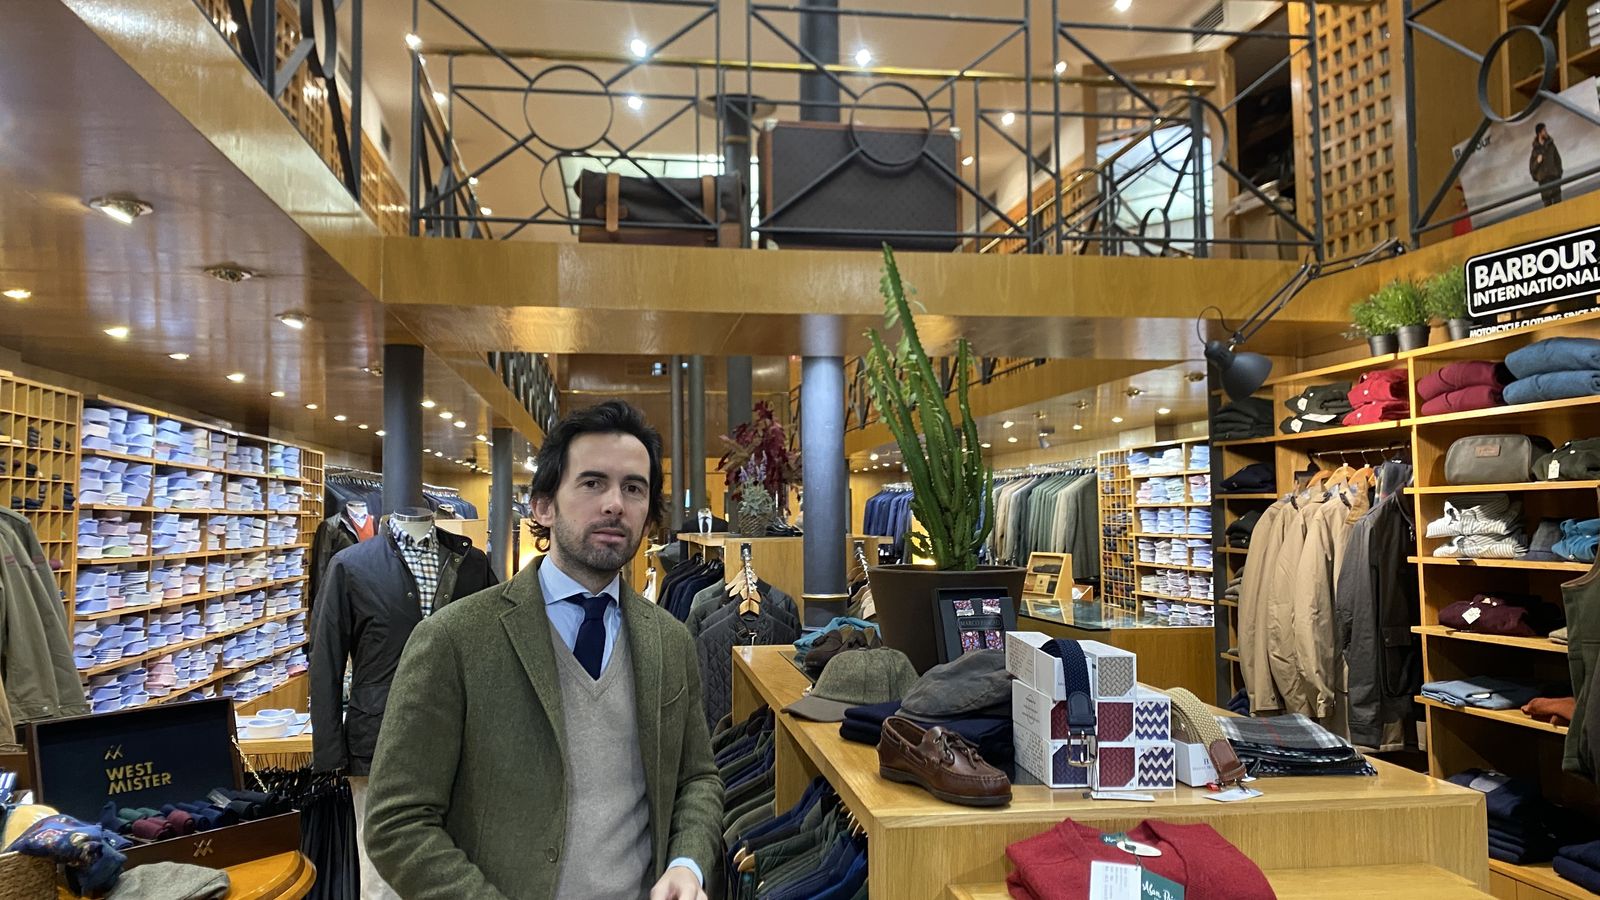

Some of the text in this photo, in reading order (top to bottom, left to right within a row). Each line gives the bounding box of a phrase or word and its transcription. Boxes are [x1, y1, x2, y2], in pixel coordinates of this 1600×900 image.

[1455, 135, 1491, 160] Bour
[1474, 239, 1597, 290] BARBOUR
[1473, 267, 1600, 307] INTERNATIONAL
[1469, 322, 1520, 338] MOTORCYCLE
[1521, 314, 1562, 328] CLOTHING
[106, 762, 153, 781] WEST
[108, 772, 171, 795] MISTER
